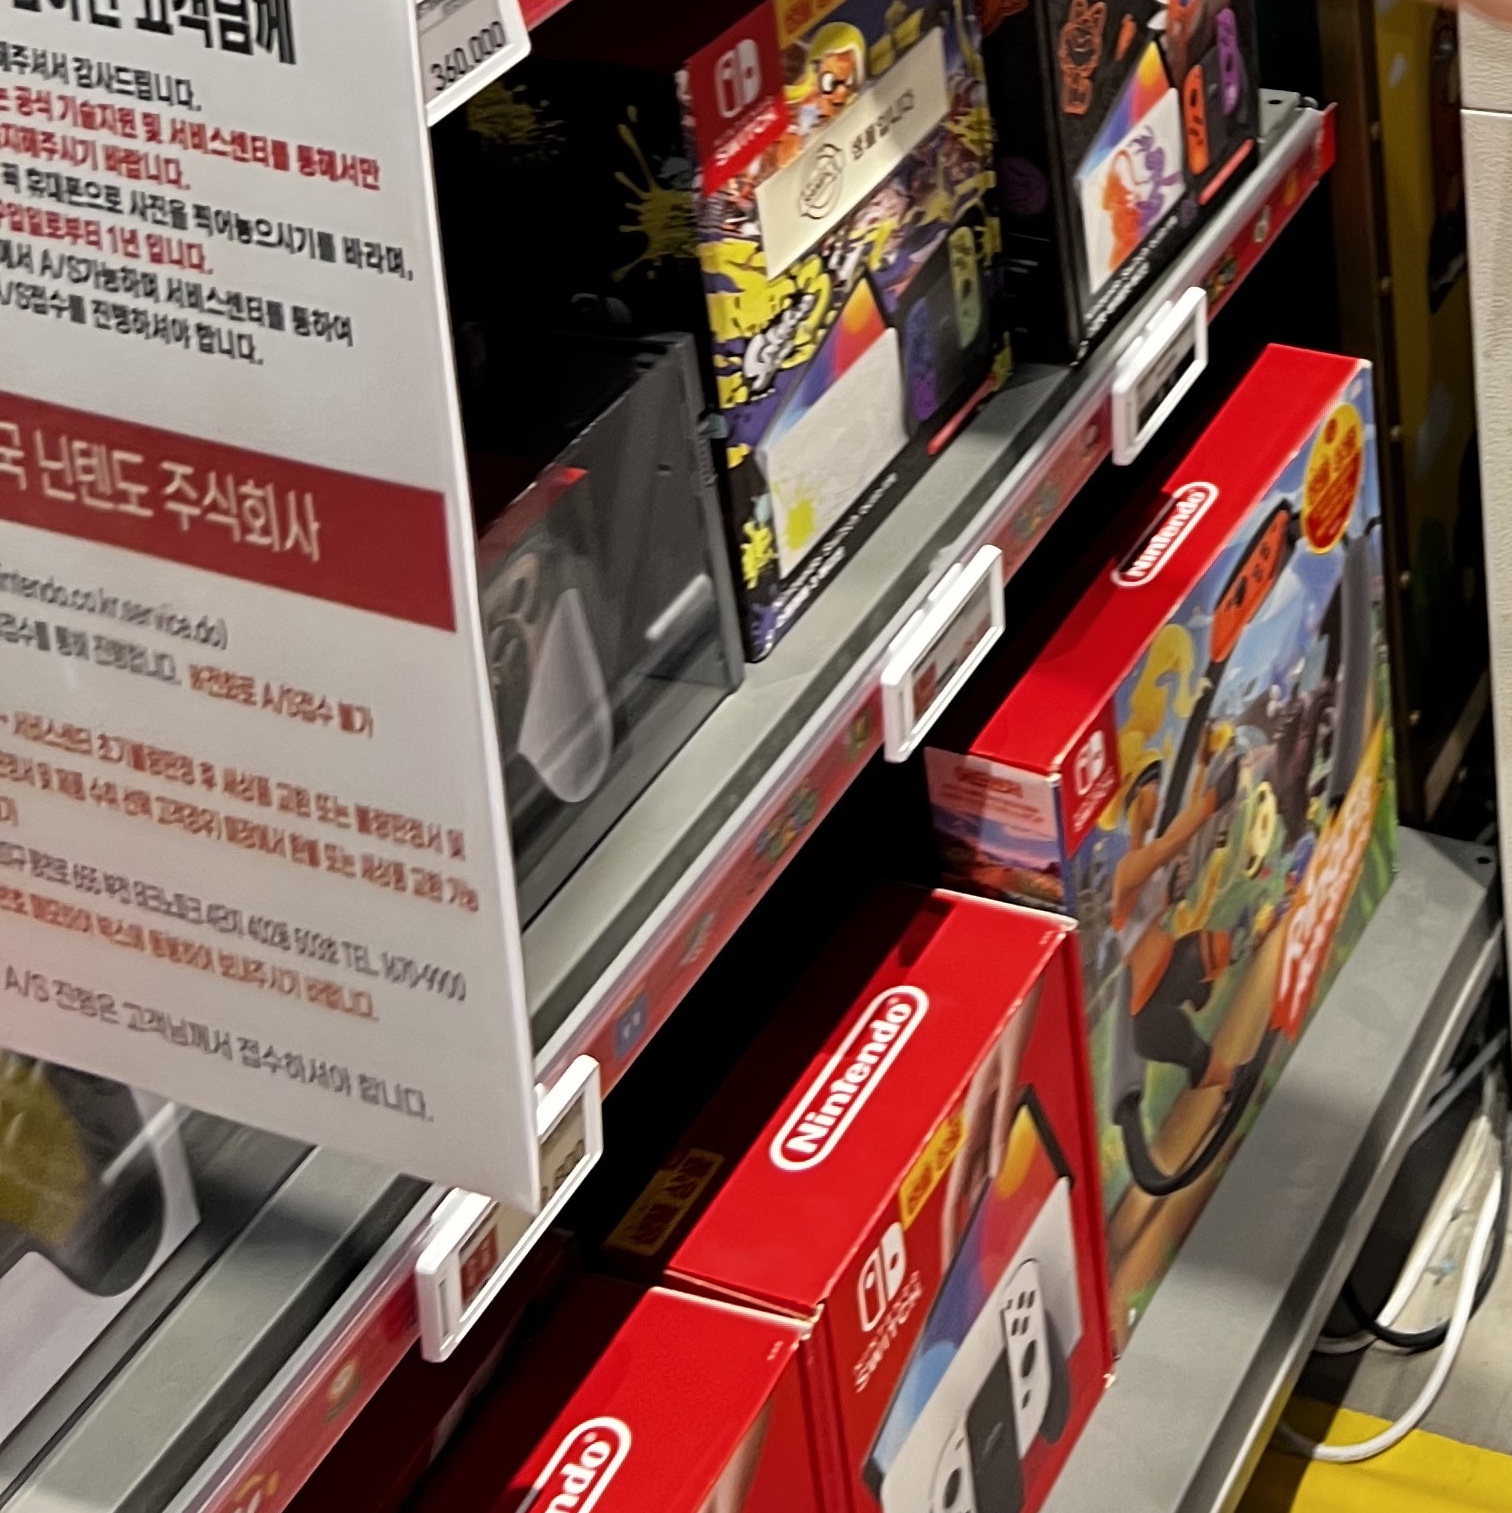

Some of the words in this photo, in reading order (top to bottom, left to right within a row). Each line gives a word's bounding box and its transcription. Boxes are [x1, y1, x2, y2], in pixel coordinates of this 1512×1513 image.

[72, 56, 202, 112] 감사드립니다.
[431, 20, 508, 92] 360,000
[0, 199, 104, 252] 입일로부터
[32, 428, 155, 518] 닌텐도
[159, 459, 321, 564] 주식회사
[1124, 490, 1207, 578] Nintendo
[4, 963, 50, 1003] A/S
[785, 996, 913, 1154] Nintendo
